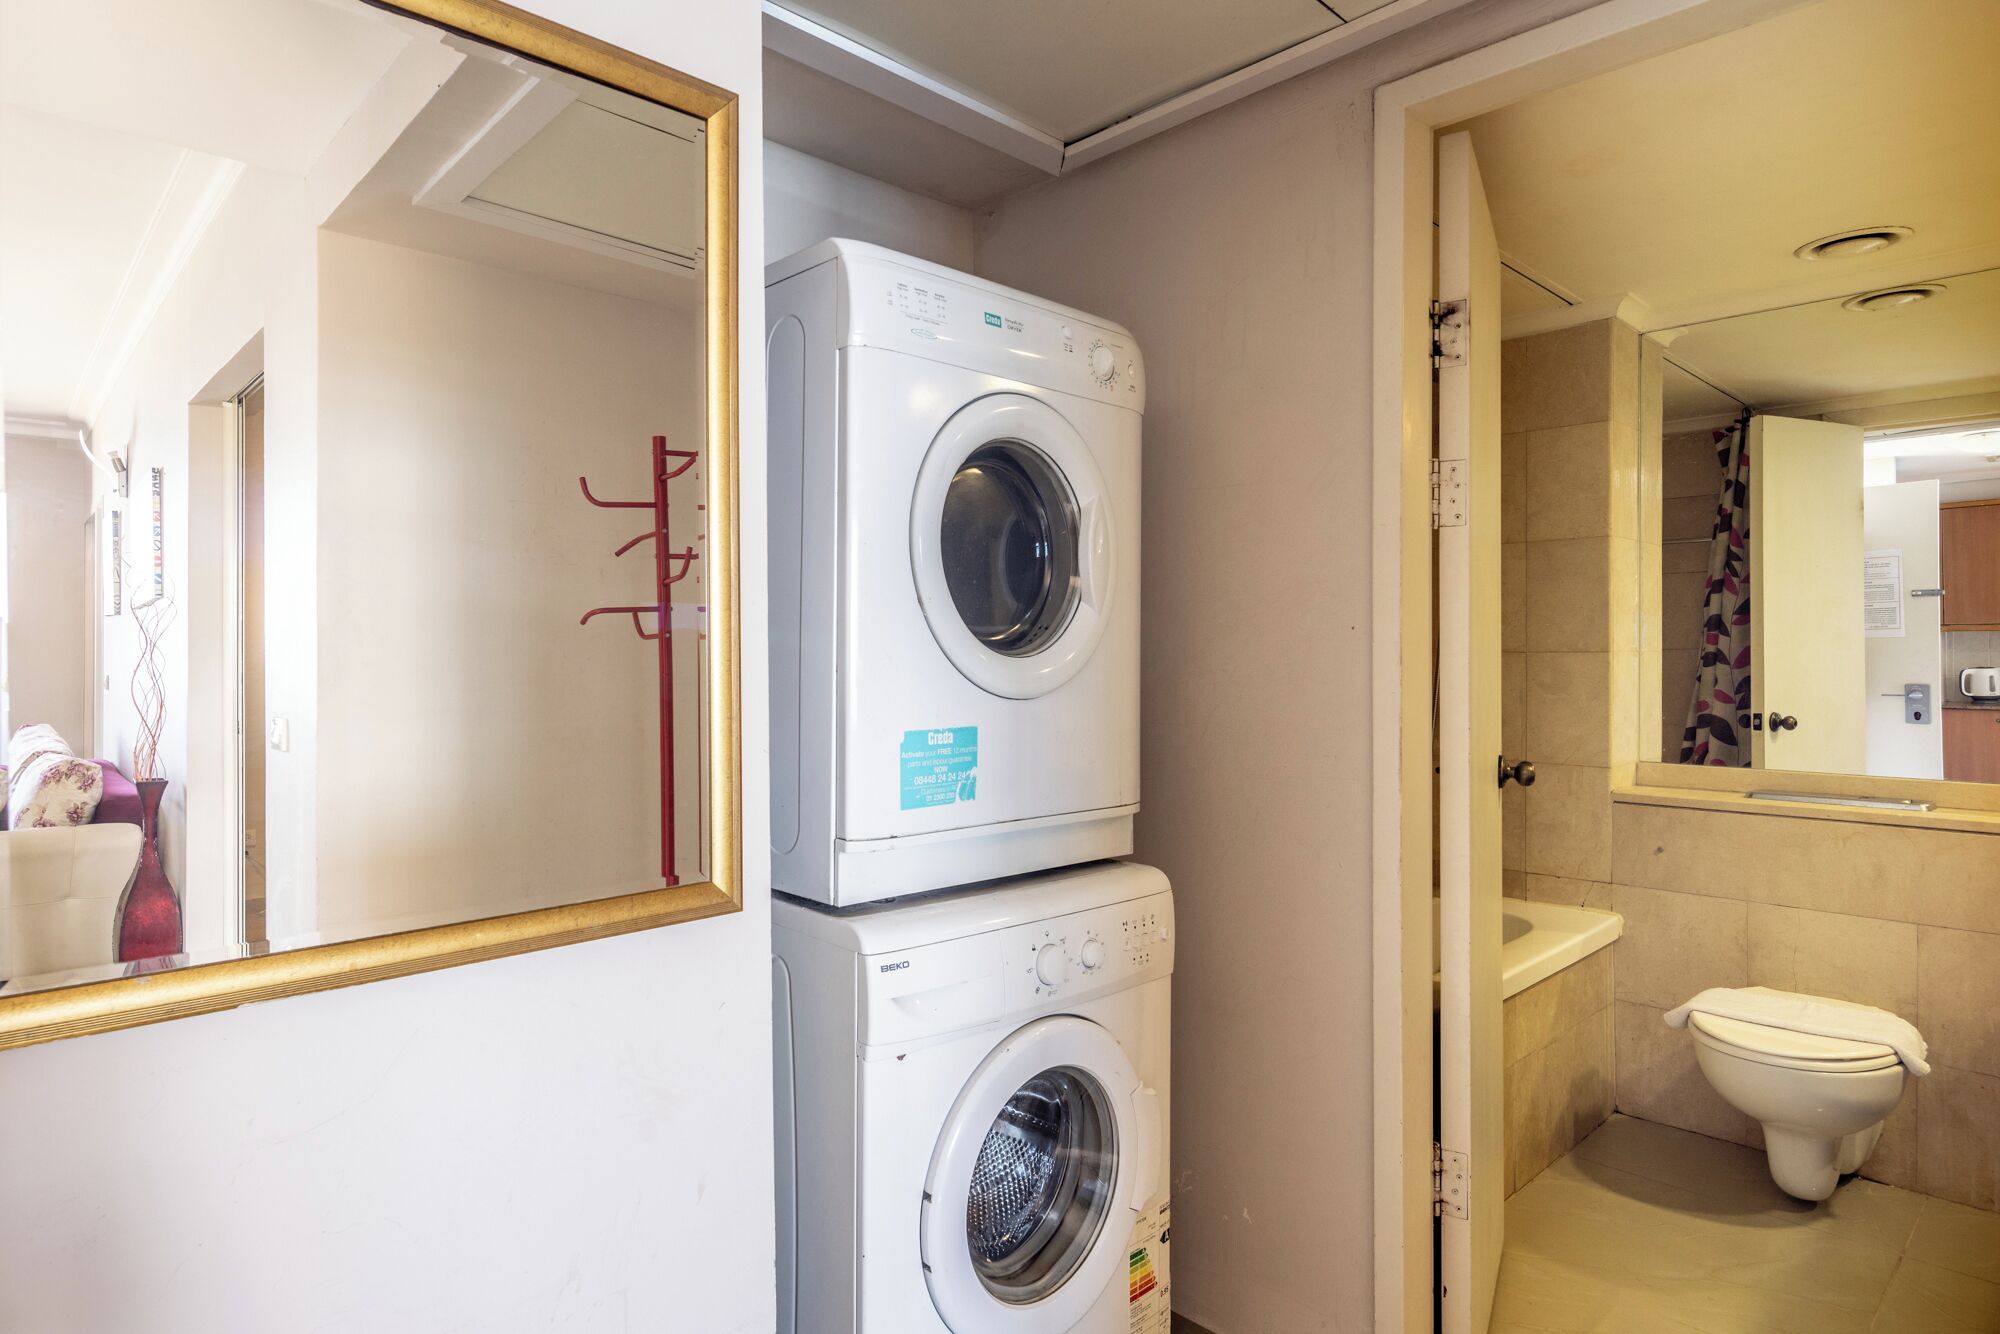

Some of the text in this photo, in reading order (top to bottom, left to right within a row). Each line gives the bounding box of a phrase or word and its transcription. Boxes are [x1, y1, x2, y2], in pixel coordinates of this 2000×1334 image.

[986, 314, 1001, 326] Creda
[928, 731, 954, 745] Creda
[937, 773, 946, 783] 24
[947, 772, 956, 781] 24
[880, 960, 910, 973] BEKO
